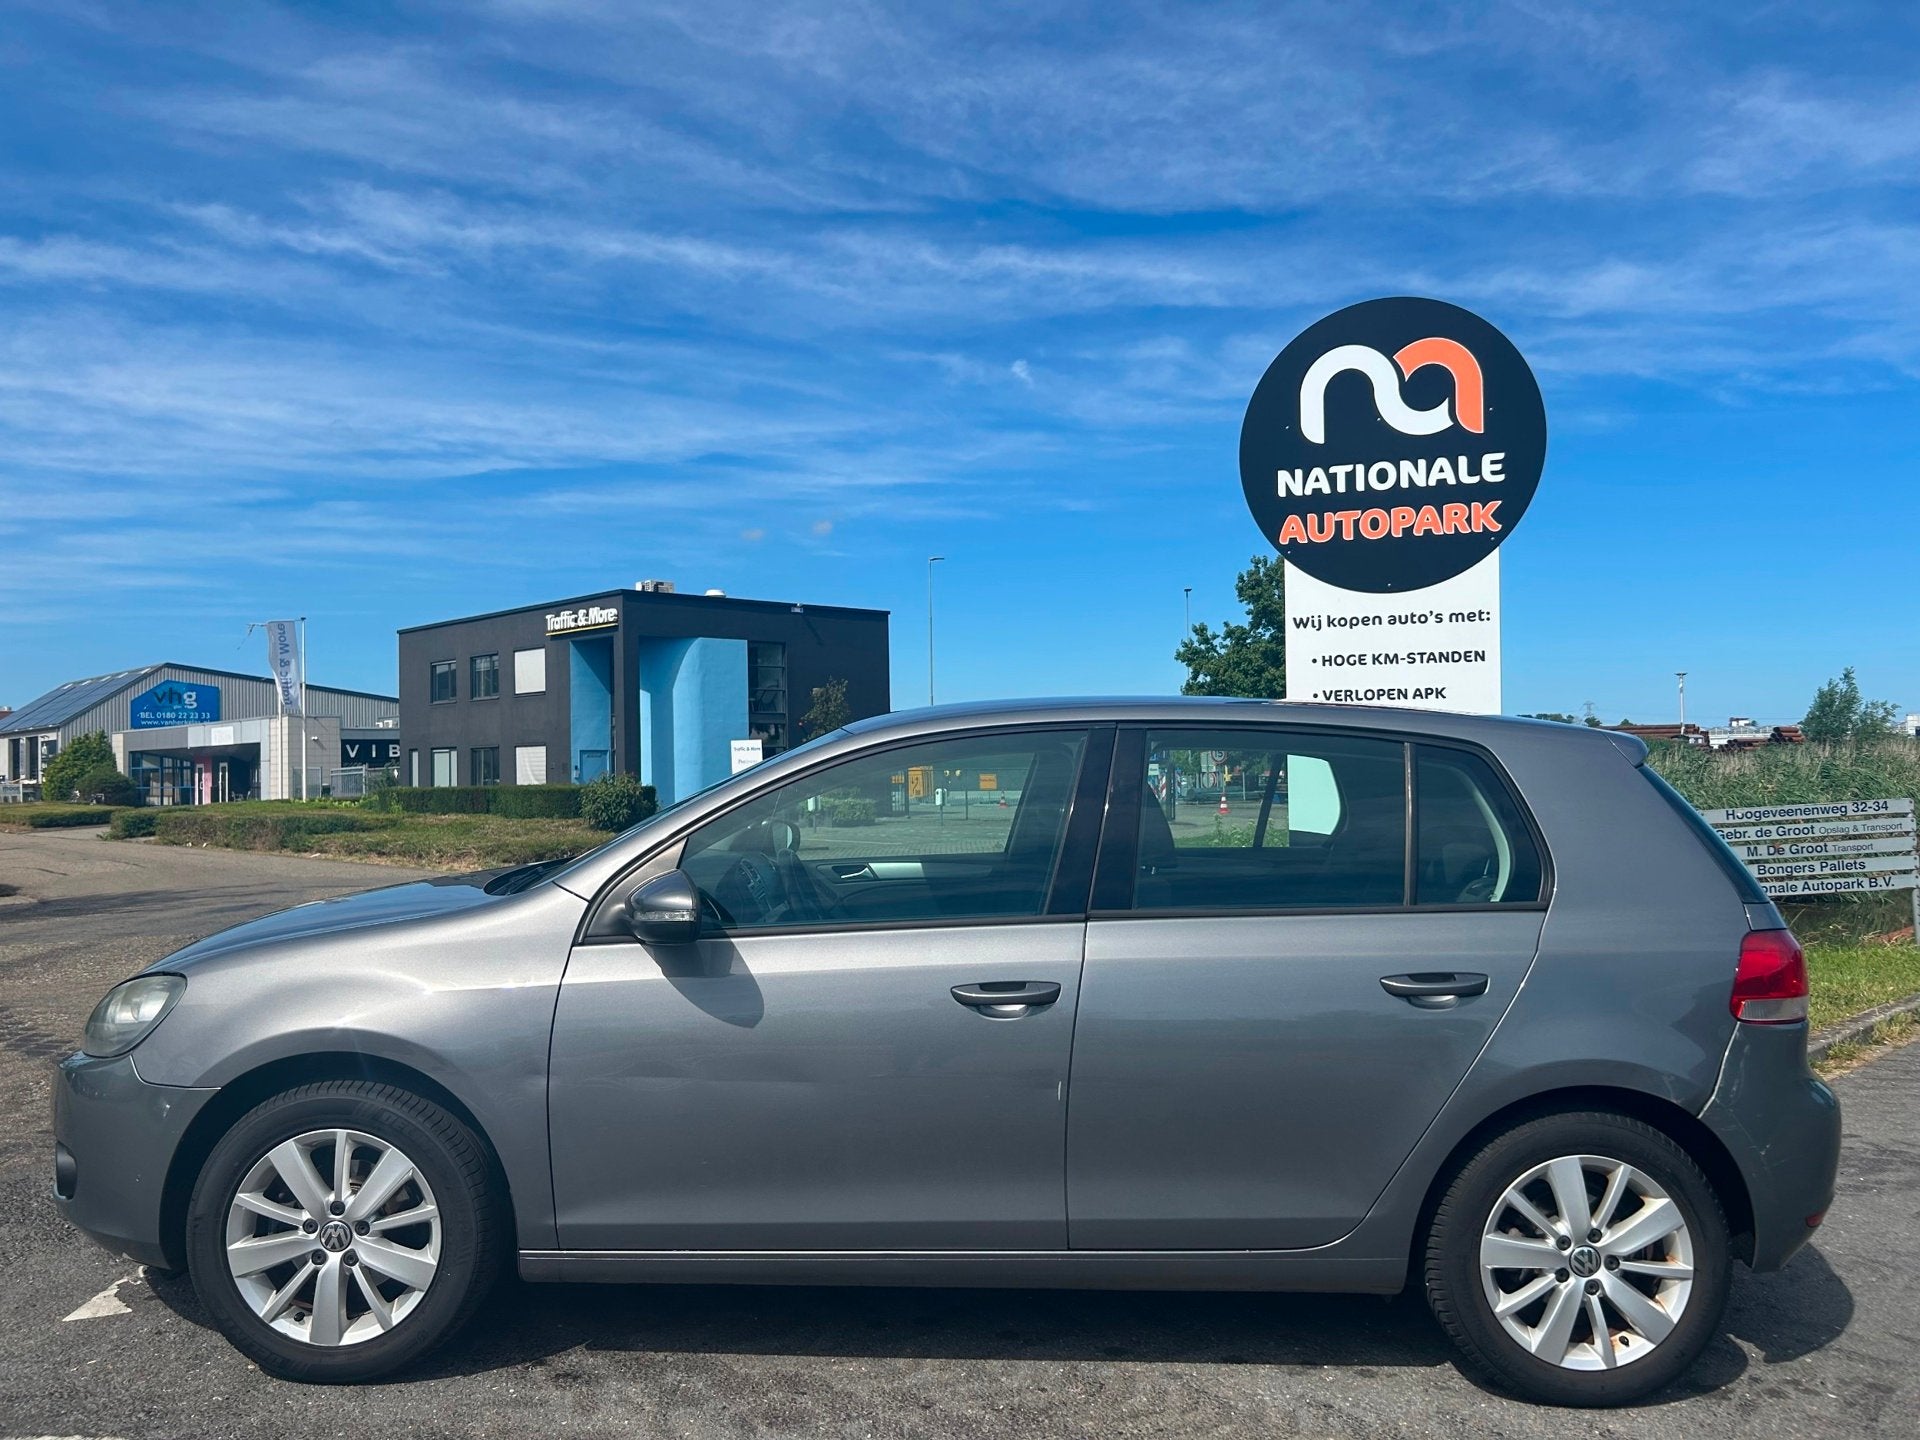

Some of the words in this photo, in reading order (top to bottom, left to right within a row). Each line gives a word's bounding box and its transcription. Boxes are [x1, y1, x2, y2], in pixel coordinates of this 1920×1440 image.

[1277, 452, 1506, 498] NATIONALE
[1279, 500, 1503, 545] AUTOPARK
[545, 610, 577, 631] Traffic
[578, 609, 588, 626] &
[588, 607, 618, 625] More
[1293, 615, 1322, 632] Wij
[1327, 614, 1383, 630] kopen
[1387, 610, 1444, 626] auto's
[1449, 608, 1491, 623] met:
[1321, 653, 1368, 667] HOGE
[1372, 650, 1486, 665] KM-STANDEN
[153, 687, 198, 709] vhg
[1322, 688, 1408, 702] VERLOPEN
[1412, 687, 1447, 700] APK
[1726, 805, 1848, 820] Hoogeveenenweg
[1851, 800, 1889, 813] 32-34
[1755, 827, 1772, 838] de
[1776, 825, 1815, 837] Groot
[1819, 825, 1850, 835] Opslag
[1852, 824, 1859, 832] &
[1861, 822, 1903, 832] Transport
[1747, 846, 1763, 857] M.
[1767, 845, 1785, 855] De
[1789, 843, 1829, 855] Groot
[1832, 843, 1874, 852] Transport
[1757, 864, 1816, 877] Bongers
[1820, 860, 1866, 872] Pallets
[1761, 881, 1798, 894] onale
[1801, 879, 1864, 892] Autopark
[1868, 876, 1895, 888] B.V.
